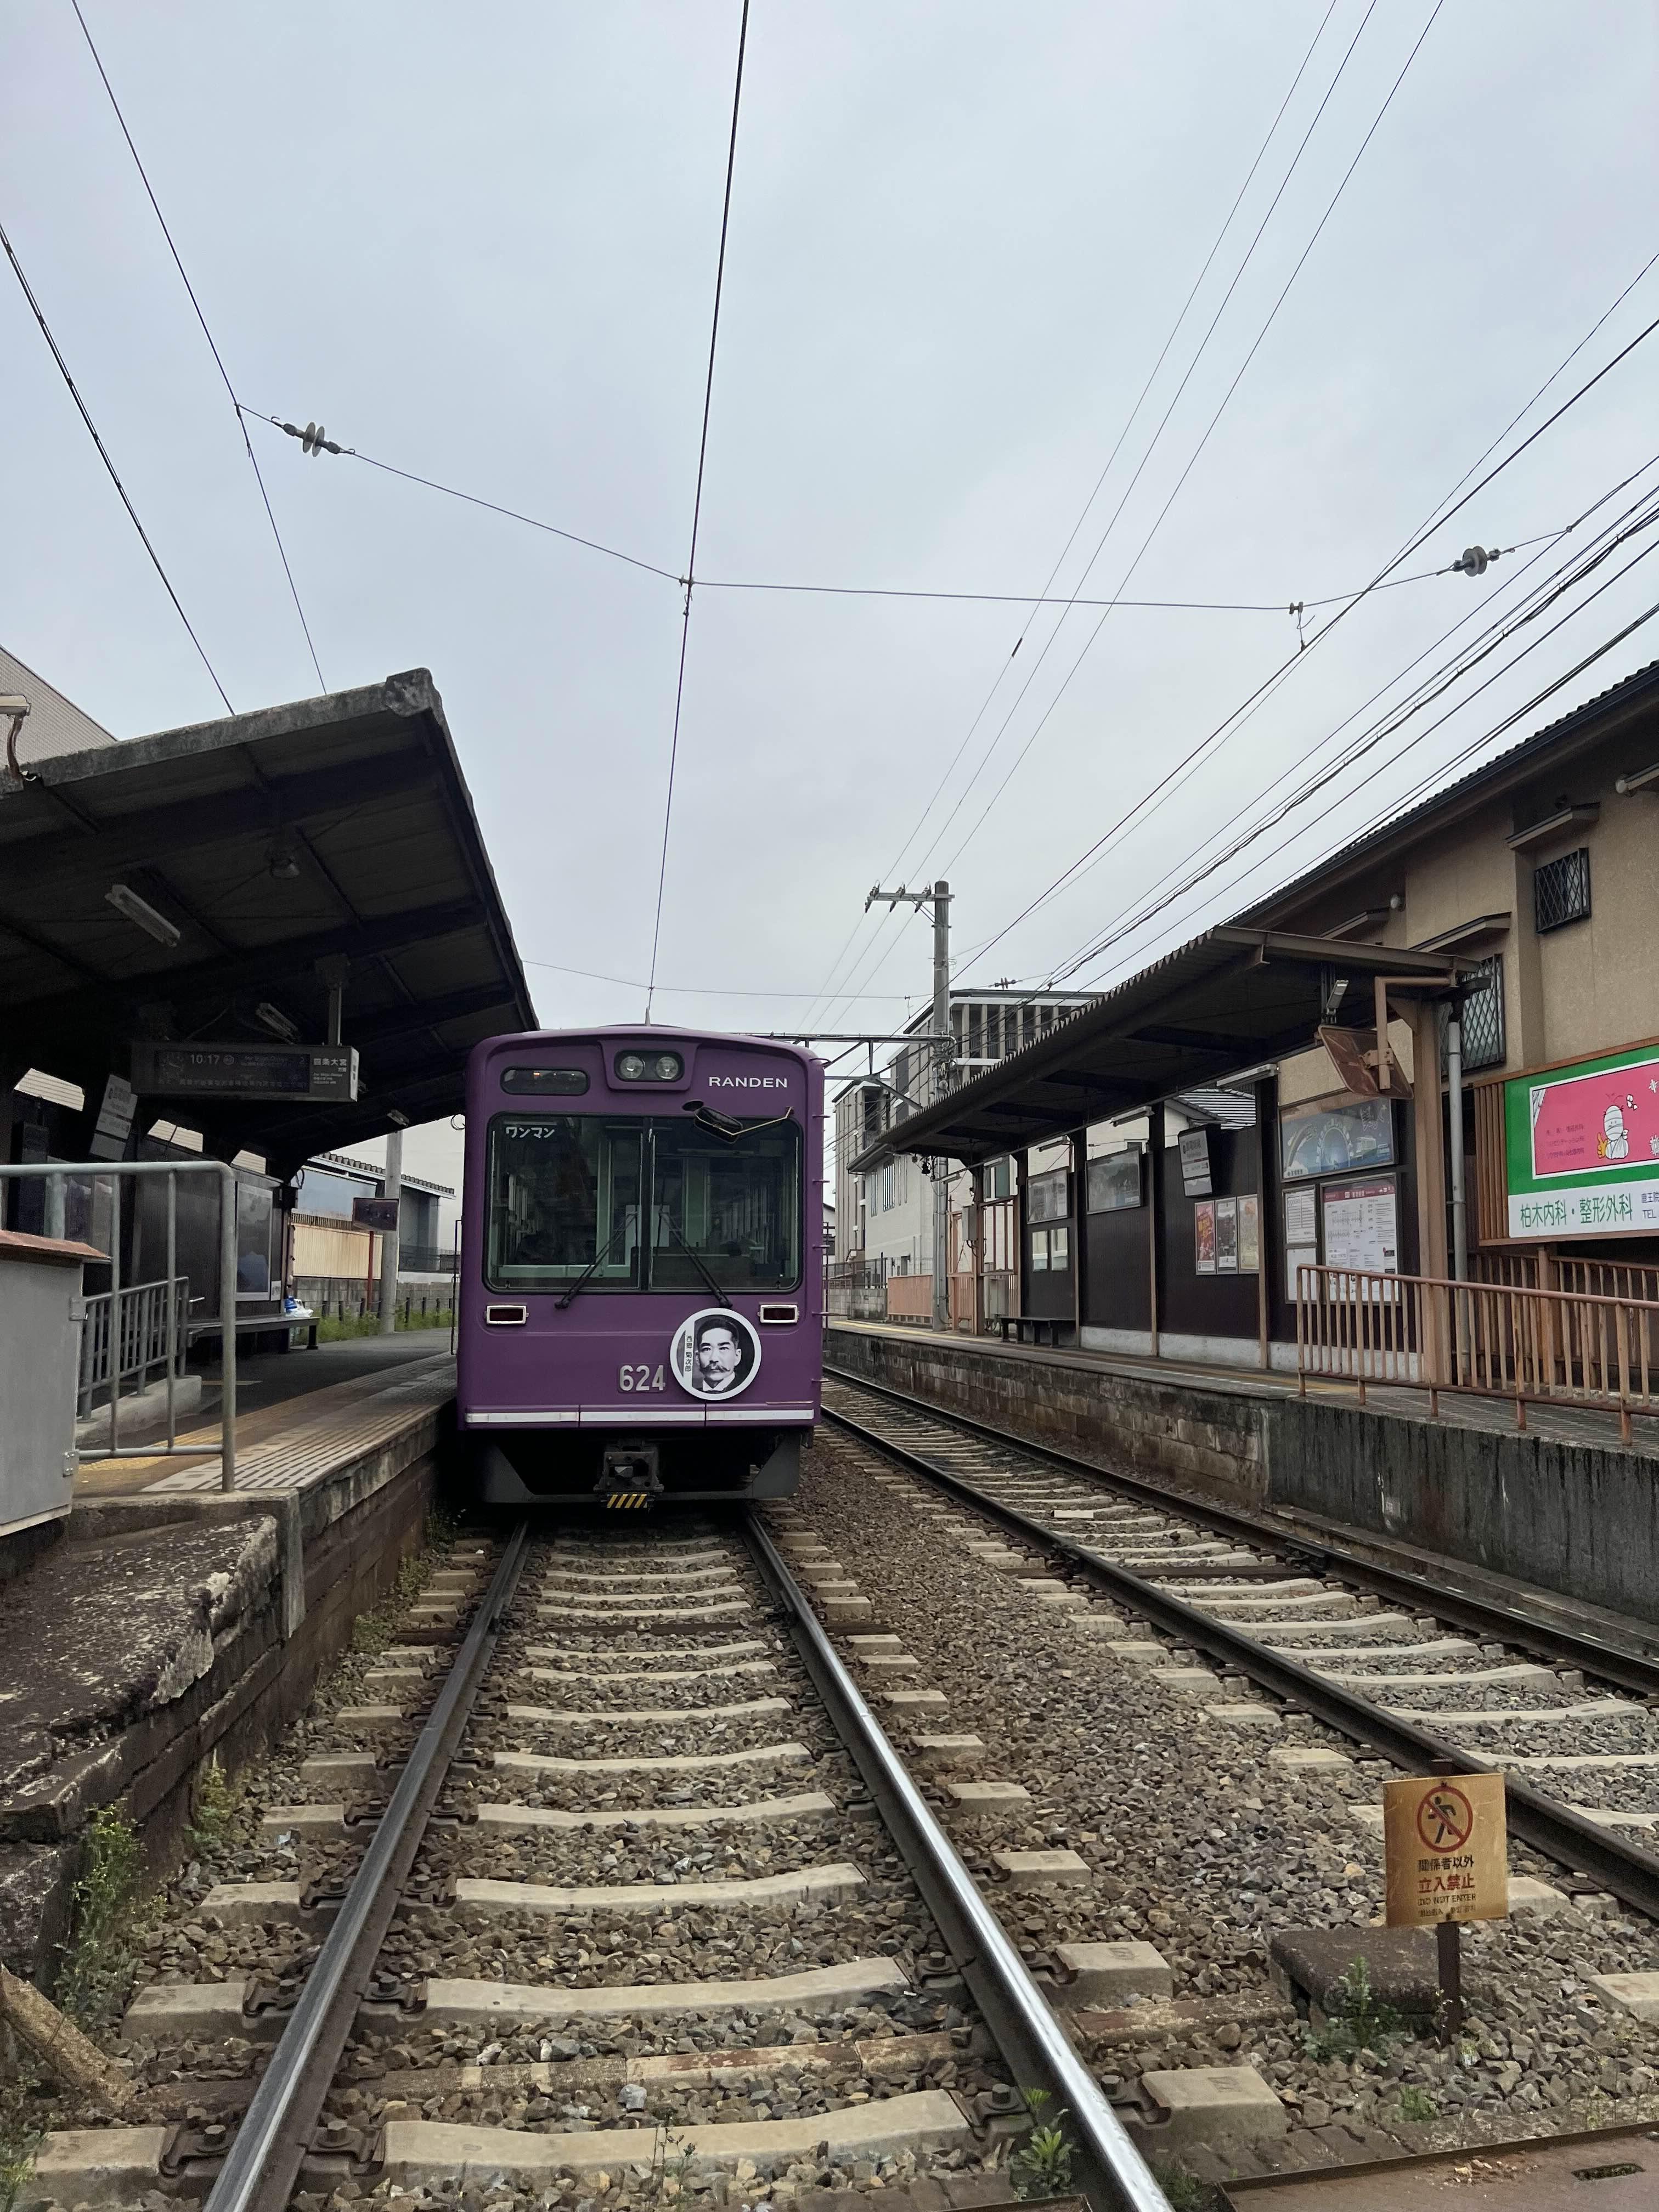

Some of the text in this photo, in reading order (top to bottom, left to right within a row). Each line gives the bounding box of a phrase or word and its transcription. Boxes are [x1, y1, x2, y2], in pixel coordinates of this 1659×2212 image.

[709, 1077, 788, 1088] RANDEN
[506, 1126, 555, 1138] ワンマン
[1642, 1209, 1657, 1219] TEL
[619, 1365, 666, 1391] 624
[1417, 1855, 1474, 1872] 関係者以外
[1418, 1873, 1476, 1893] 立入禁止
[1417, 1893, 1476, 1906] DO NOT ENTER
